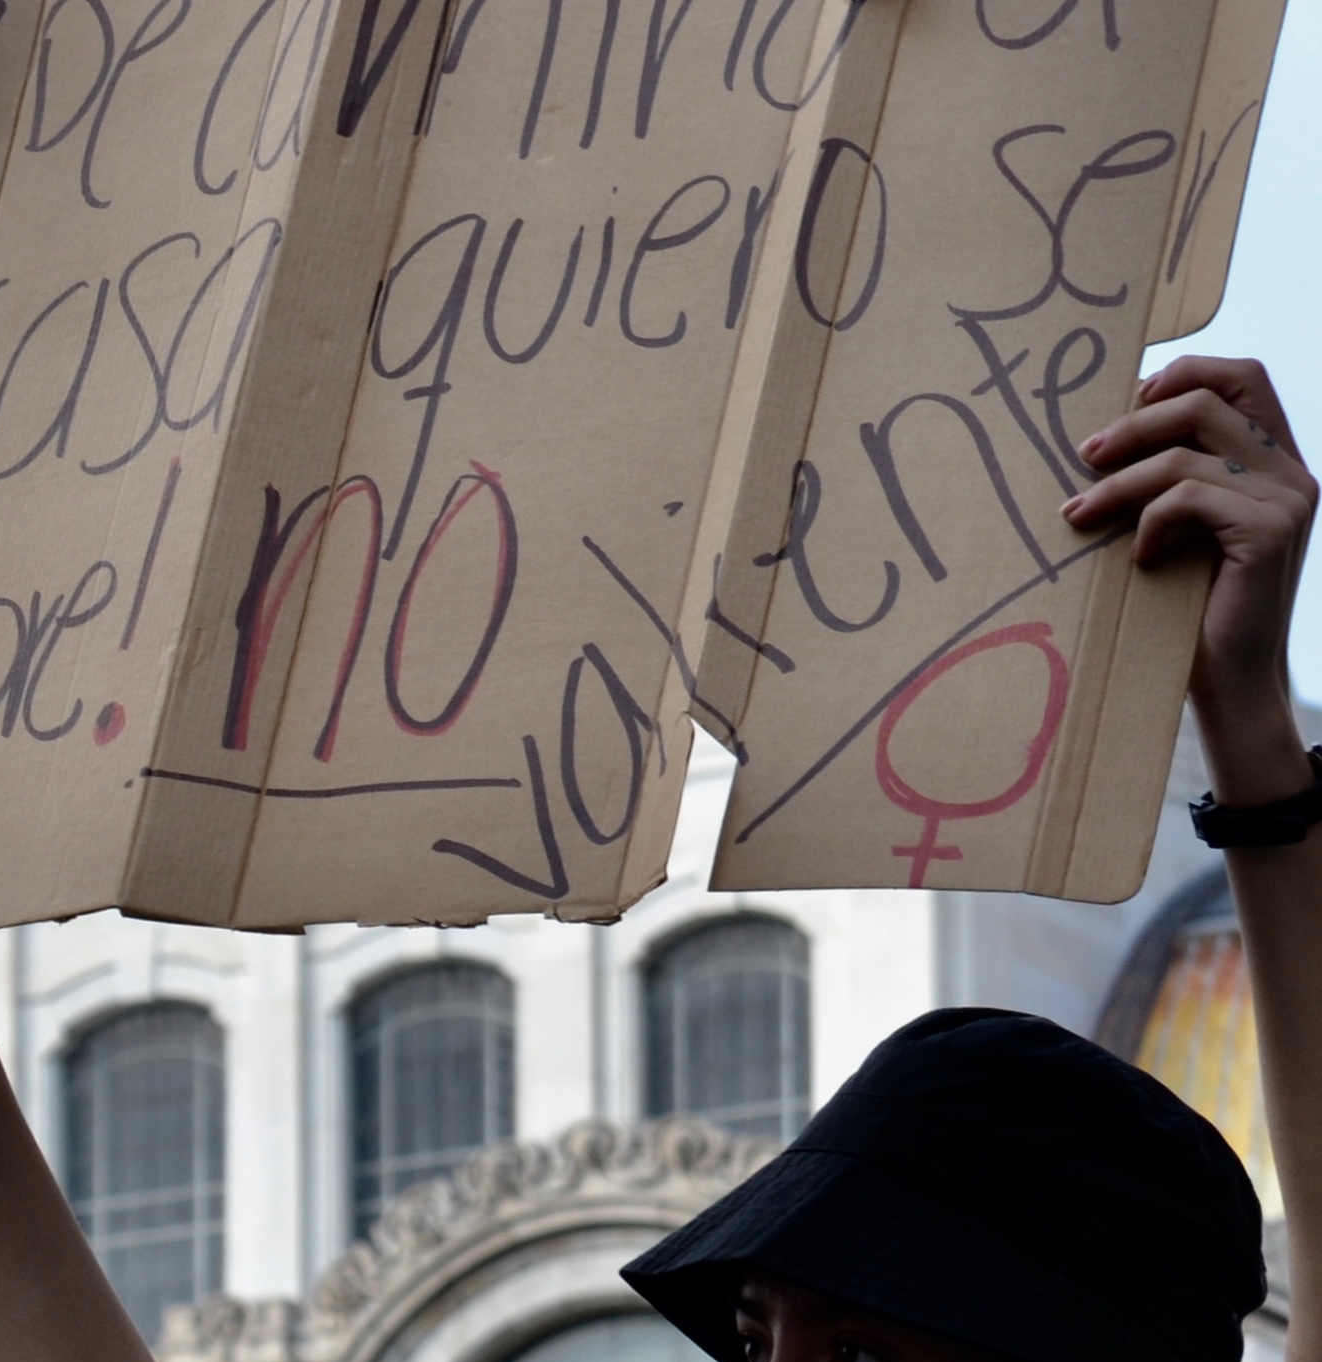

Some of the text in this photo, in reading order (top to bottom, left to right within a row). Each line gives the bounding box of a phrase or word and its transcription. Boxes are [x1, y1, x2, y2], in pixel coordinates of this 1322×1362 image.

[368, 138, 888, 562] quiero
[946, 100, 1261, 322] ser
[221, 459, 519, 765] no
